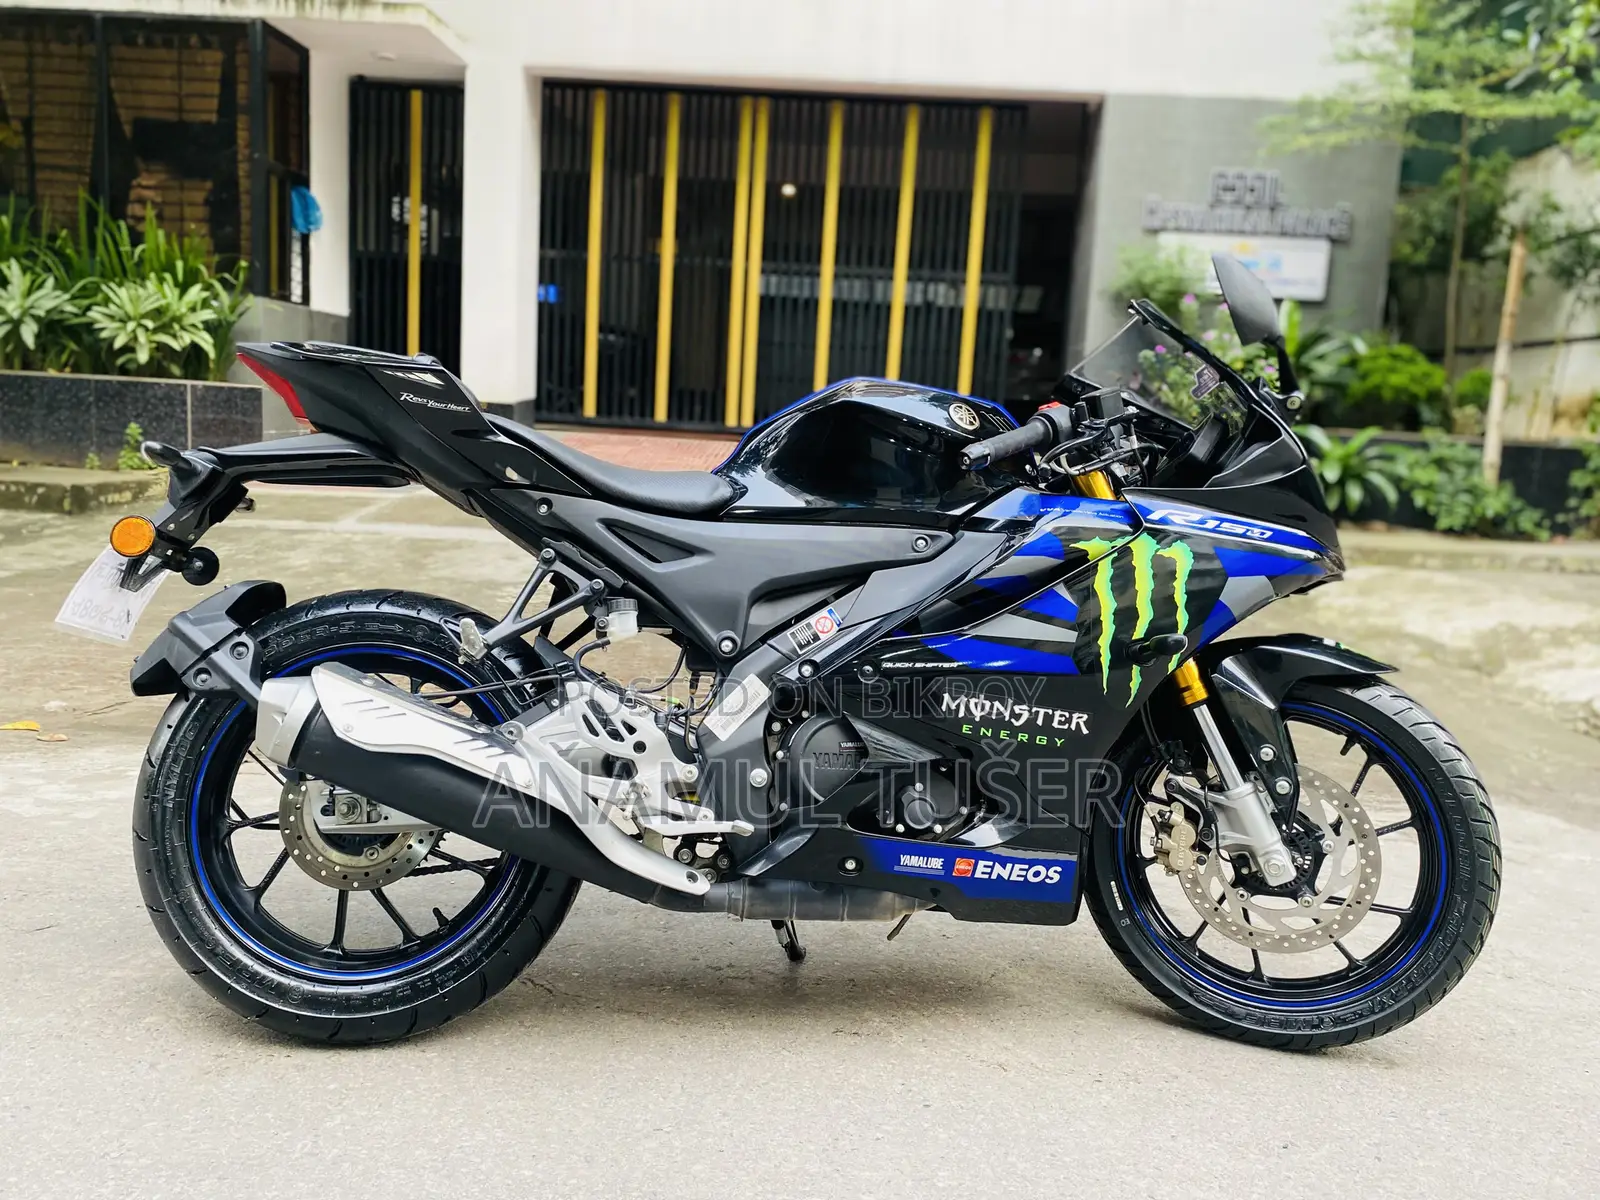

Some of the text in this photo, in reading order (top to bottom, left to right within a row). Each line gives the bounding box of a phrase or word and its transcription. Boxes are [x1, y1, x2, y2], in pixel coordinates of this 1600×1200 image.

[961, 724, 1065, 748] ENERGY
[900, 854, 944, 870] YAMALUBE
[974, 860, 1062, 884] ENEOS
